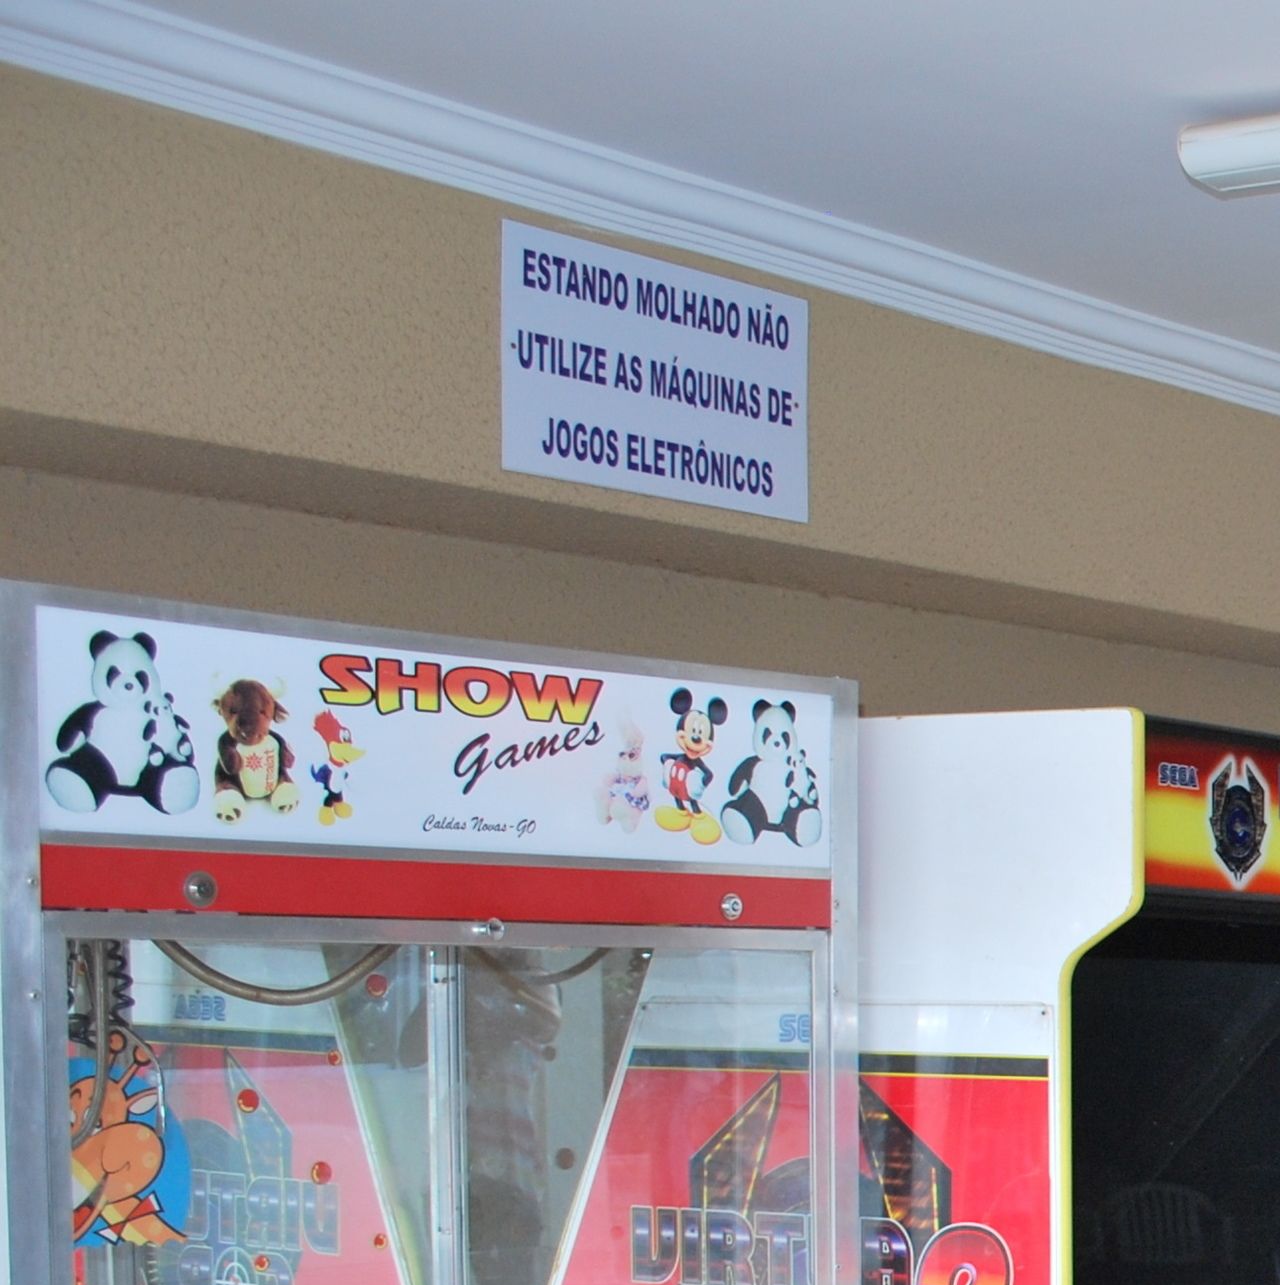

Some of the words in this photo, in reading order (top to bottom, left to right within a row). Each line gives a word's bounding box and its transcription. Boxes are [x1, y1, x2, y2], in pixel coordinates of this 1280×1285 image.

[522, 247, 629, 311] ESTANDO
[636, 277, 741, 339] MOLHADO
[747, 303, 790, 351] NÃO
[516, 329, 607, 386] UTILIZE
[614, 352, 643, 393] AS
[650, 356, 761, 419] MÁQUINAS
[767, 387, 794, 427] DE
[541, 417, 620, 467] JOGOS
[626, 433, 774, 498] ELETRÔNICOS
[319, 652, 604, 726] SHOW
[453, 721, 606, 795] Games
[1157, 761, 1201, 790] SEGA
[422, 813, 467, 832] Caldas
[778, 1013, 810, 1043] SE
